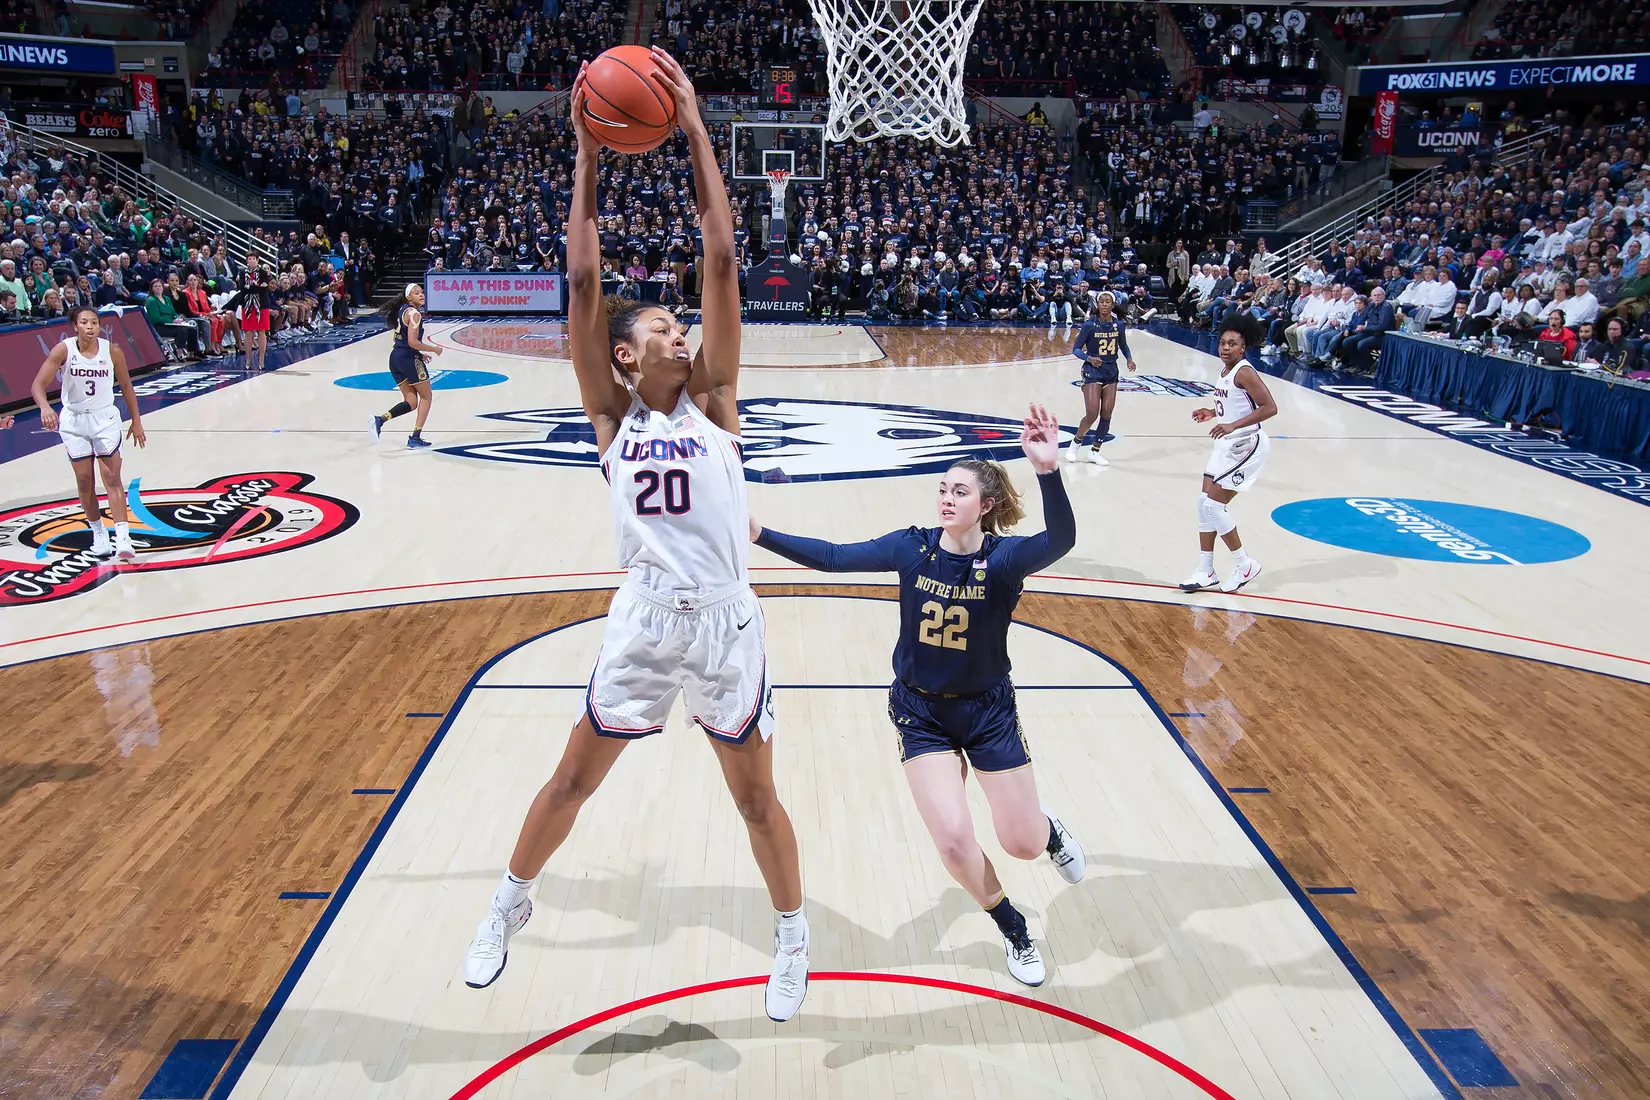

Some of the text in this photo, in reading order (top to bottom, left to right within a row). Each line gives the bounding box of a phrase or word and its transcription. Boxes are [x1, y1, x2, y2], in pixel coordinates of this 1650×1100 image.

[772, 70, 794, 82] 8:38
[775, 83, 791, 104] 15
[1325, 104, 1342, 112] 205
[25, 114, 77, 128] BEAR'S
[79, 110, 125, 128] Coke
[88, 128, 120, 137] zero
[1417, 131, 1481, 147] UCONN
[433, 280, 555, 291] SLAM THIS DUNK
[480, 295, 531, 306] DUNKIN'
[747, 301, 805, 311] TRAVELERS
[1098, 338, 1116, 356] 24
[70, 368, 109, 378] UCONN
[85, 380, 96, 397] 3
[1319, 385, 1512, 431] UCONN
[620, 436, 708, 462] UCONN
[634, 469, 691, 516] 20
[174, 479, 272, 525] Classic
[247, 508, 315, 544] 2019
[914, 574, 986, 600] NOTRE DAME
[918, 600, 969, 651] 22
